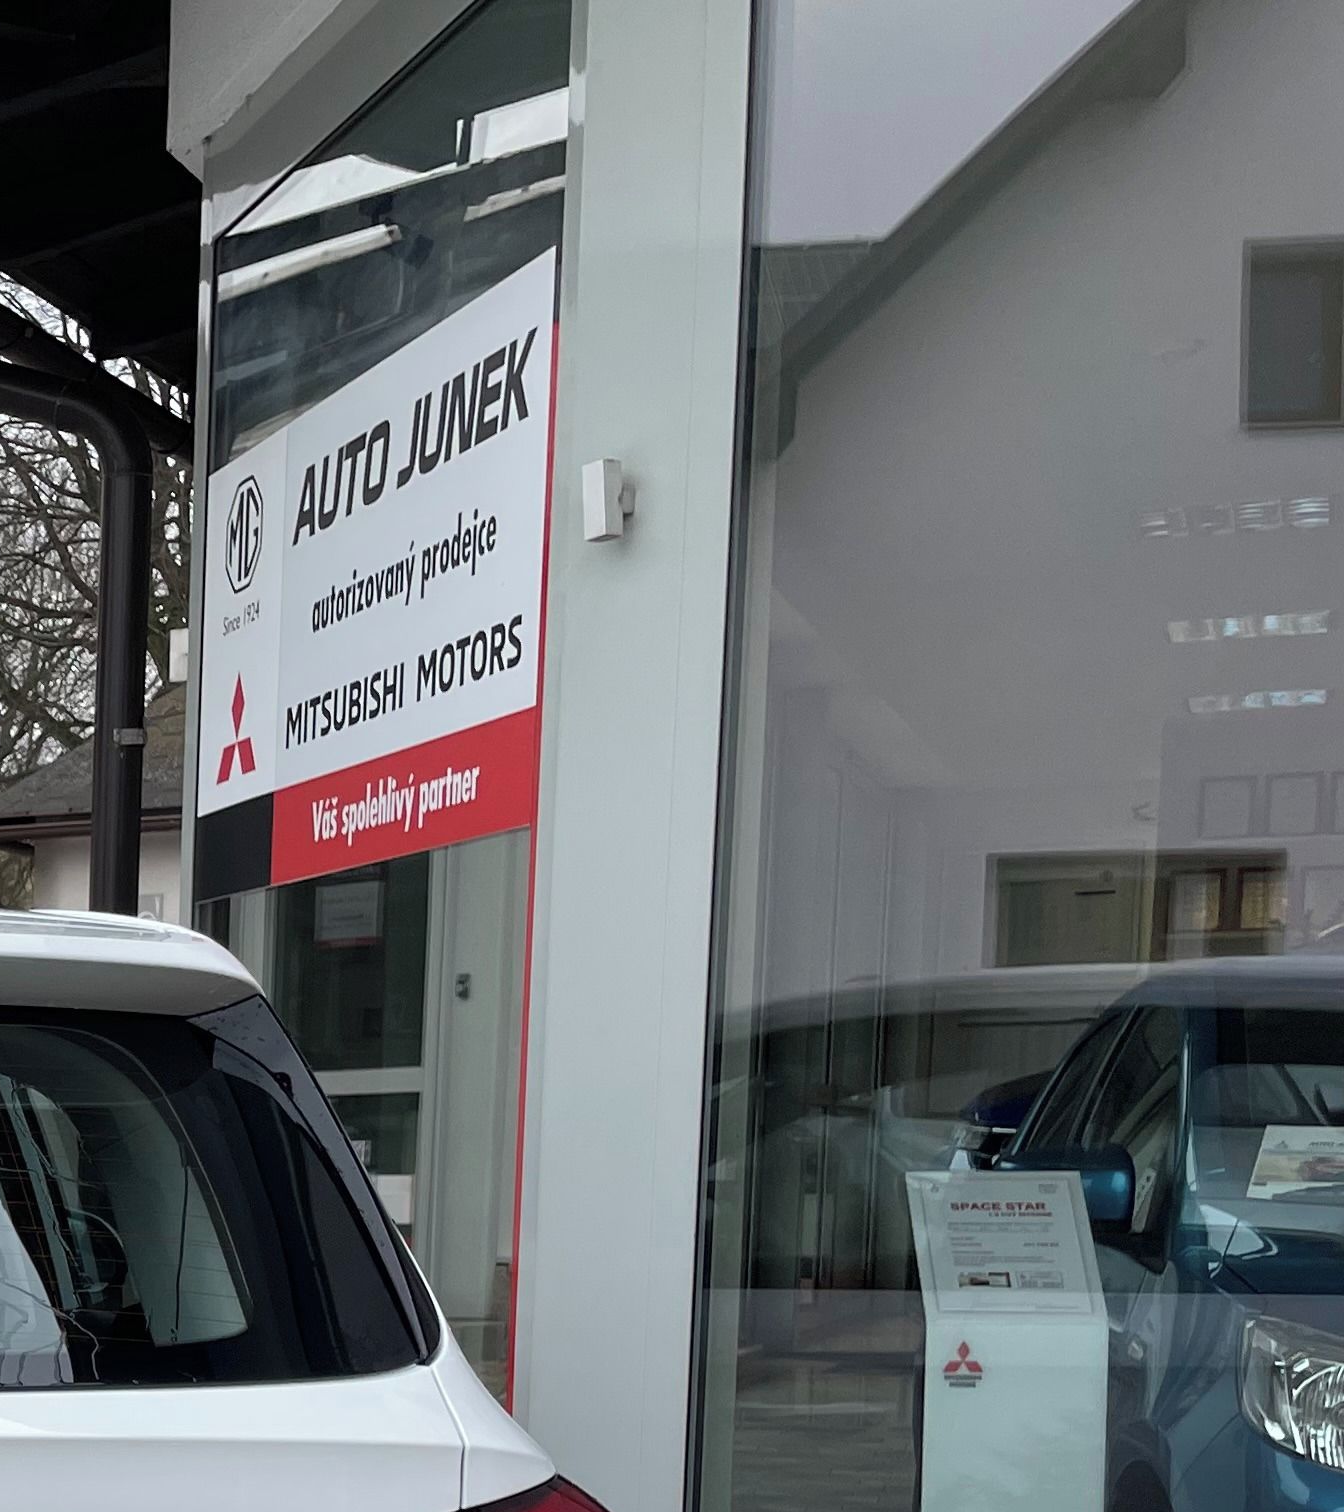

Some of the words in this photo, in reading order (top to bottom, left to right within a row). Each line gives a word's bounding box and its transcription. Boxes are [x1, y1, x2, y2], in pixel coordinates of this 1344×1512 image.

[292, 419, 390, 547] AUTO
[397, 325, 538, 490] JUNEK
[226, 481, 262, 588] MG
[312, 540, 416, 633] autorizovaný
[421, 508, 497, 600] prodejce
[222, 616, 241, 637] Since
[243, 600, 260, 627] 1924
[285, 662, 405, 750] MITSUBISHI
[416, 614, 523, 702] MOTORS
[312, 796, 338, 843] Váš
[341, 773, 414, 847] spolehlivý
[418, 766, 480, 829] partner
[950, 1201, 1001, 1211] SPACE
[1005, 1201, 1046, 1211] STAR
